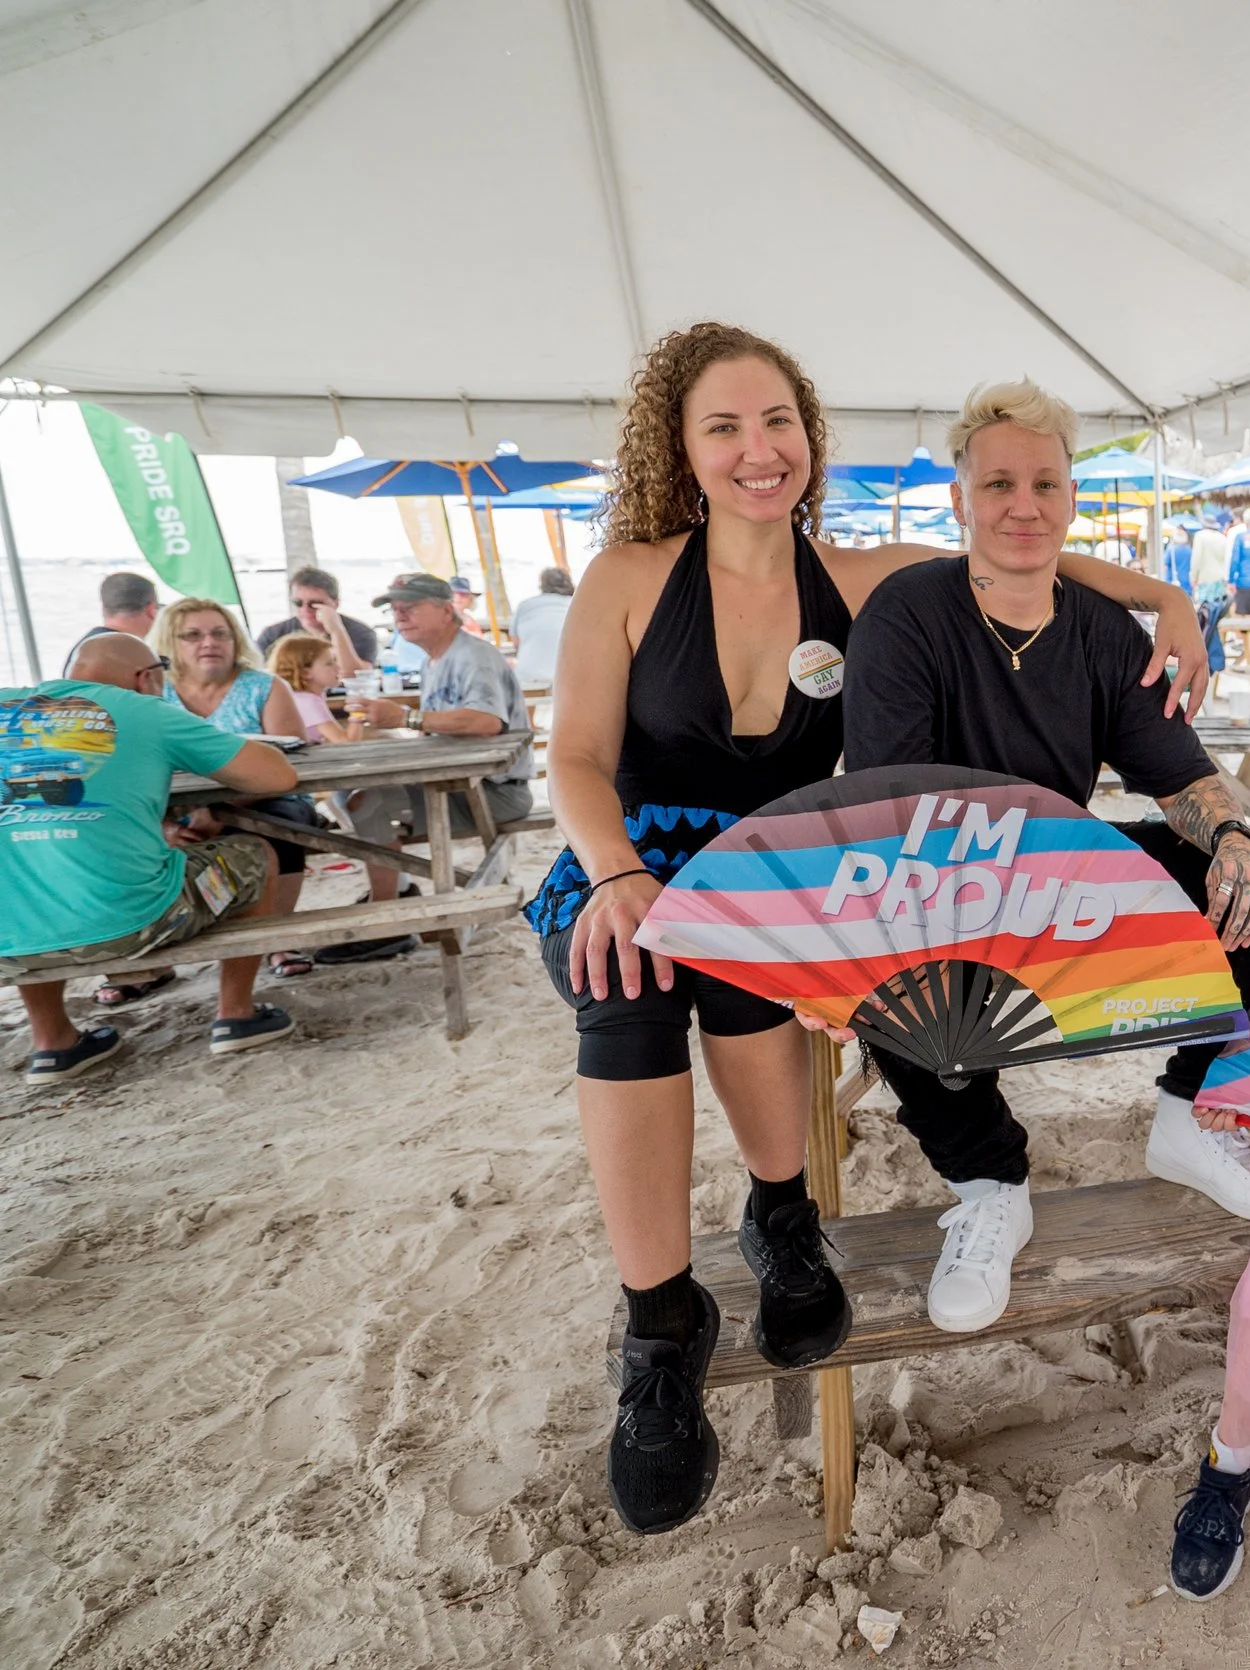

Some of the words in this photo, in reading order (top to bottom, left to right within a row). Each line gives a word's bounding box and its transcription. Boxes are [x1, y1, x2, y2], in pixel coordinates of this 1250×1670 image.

[124, 426, 174, 501] PRIDE
[154, 505, 191, 556] SRQ
[799, 652, 833, 671] AMERICA
[800, 645, 823, 659] MAKE
[813, 669, 834, 685] GAY
[818, 679, 841, 695] AGAIN
[0, 804, 106, 826] Bronco
[901, 794, 1028, 868] I'M
[821, 849, 1117, 941] PROUD
[1102, 996, 1199, 1015] PROJECT
